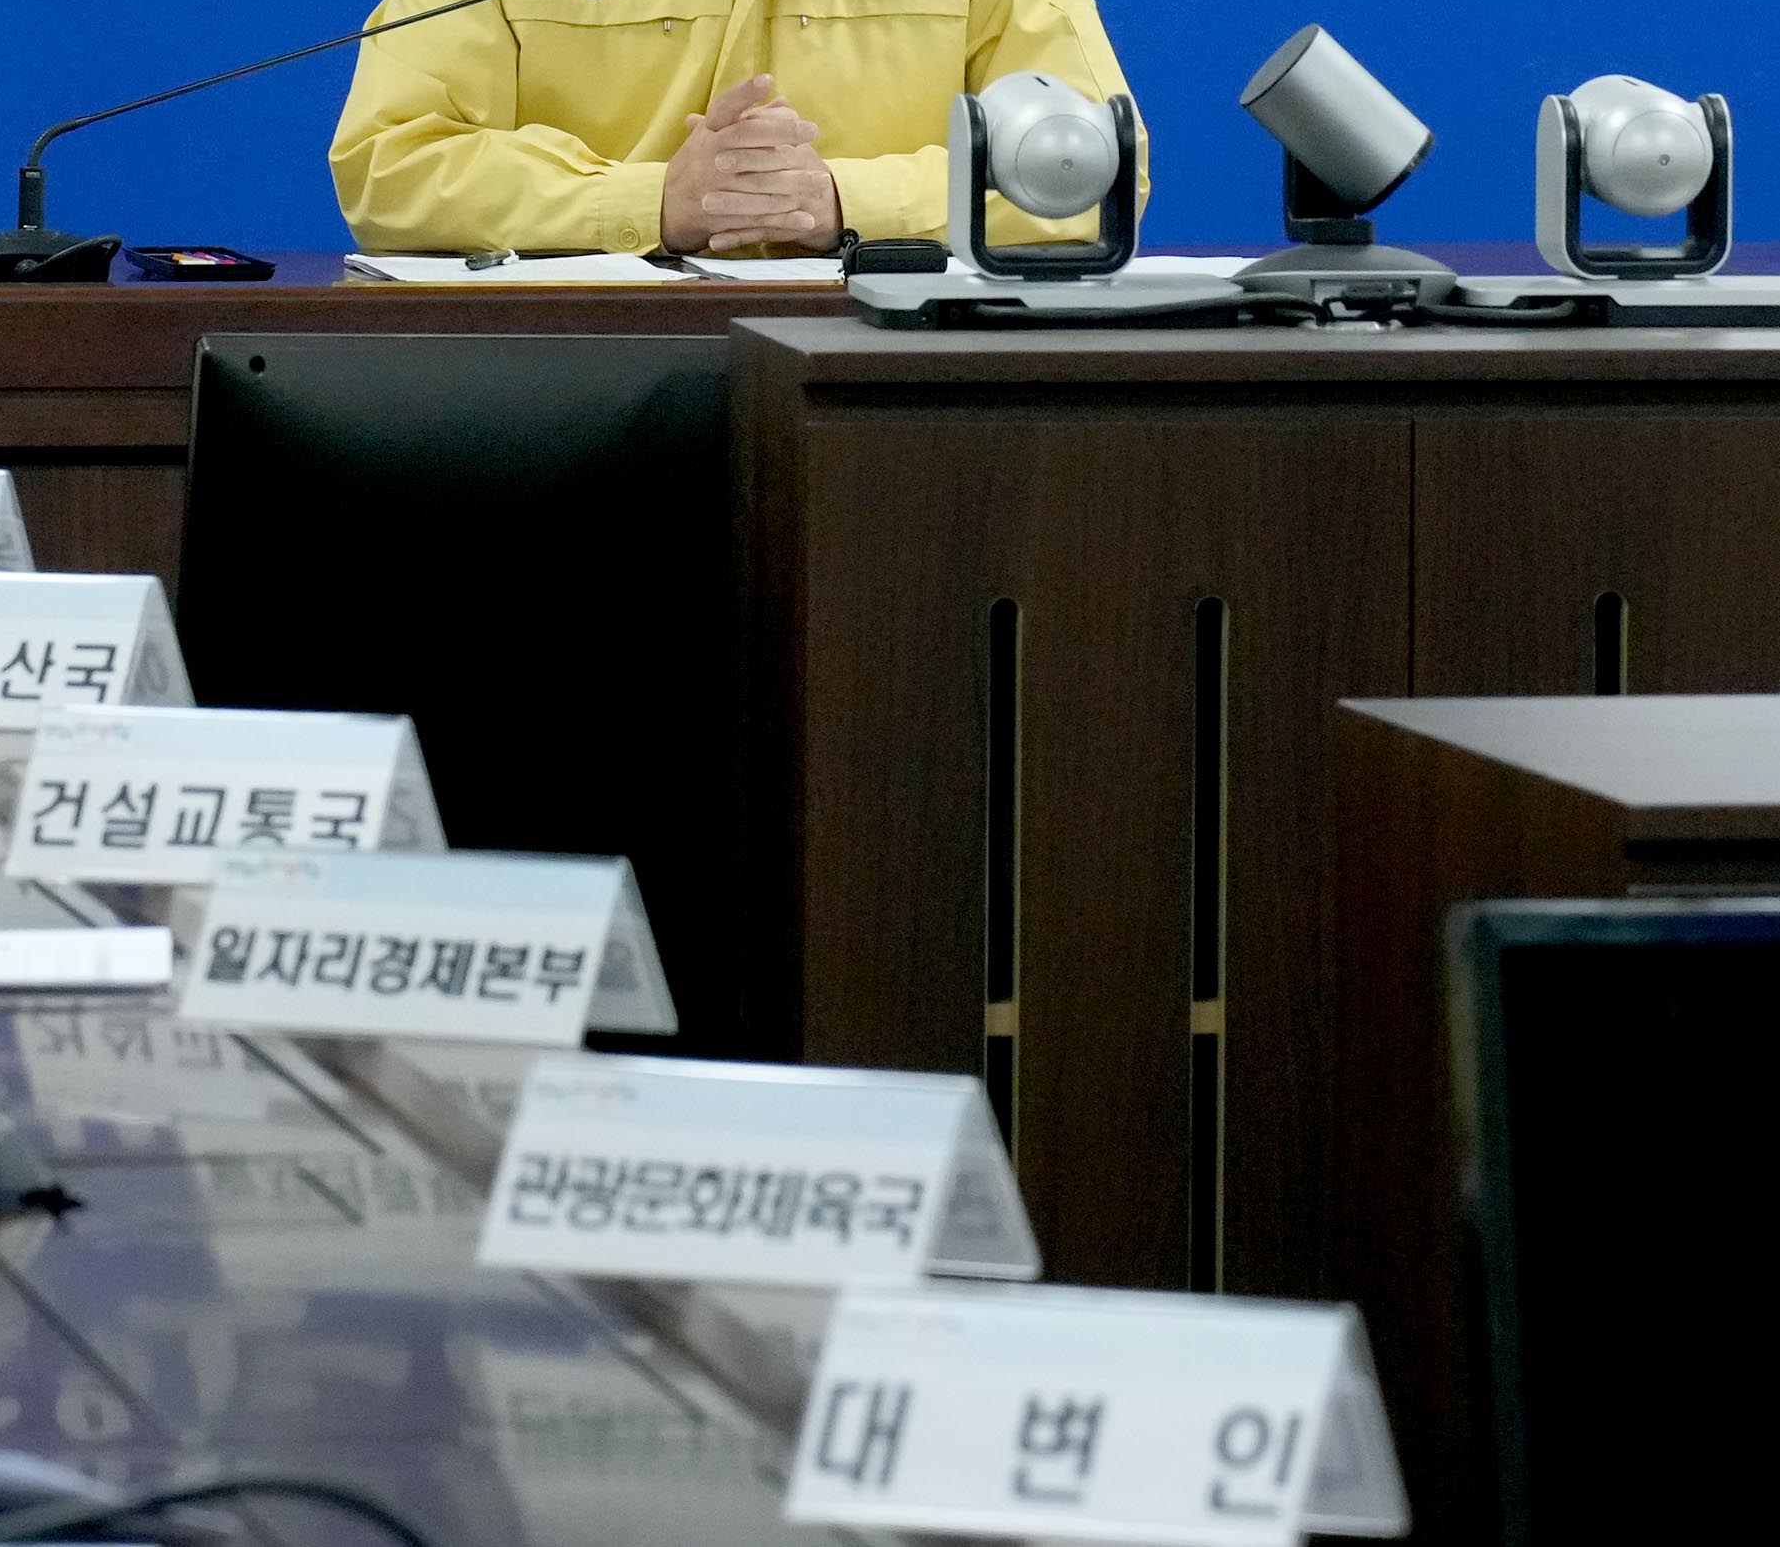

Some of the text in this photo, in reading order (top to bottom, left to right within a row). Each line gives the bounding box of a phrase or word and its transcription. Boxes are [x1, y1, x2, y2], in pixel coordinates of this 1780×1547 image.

[31, 779, 367, 848] 건설교통국
[204, 925, 584, 1005] 일자리경제본부
[505, 1150, 926, 1248] 관광문화체육국
